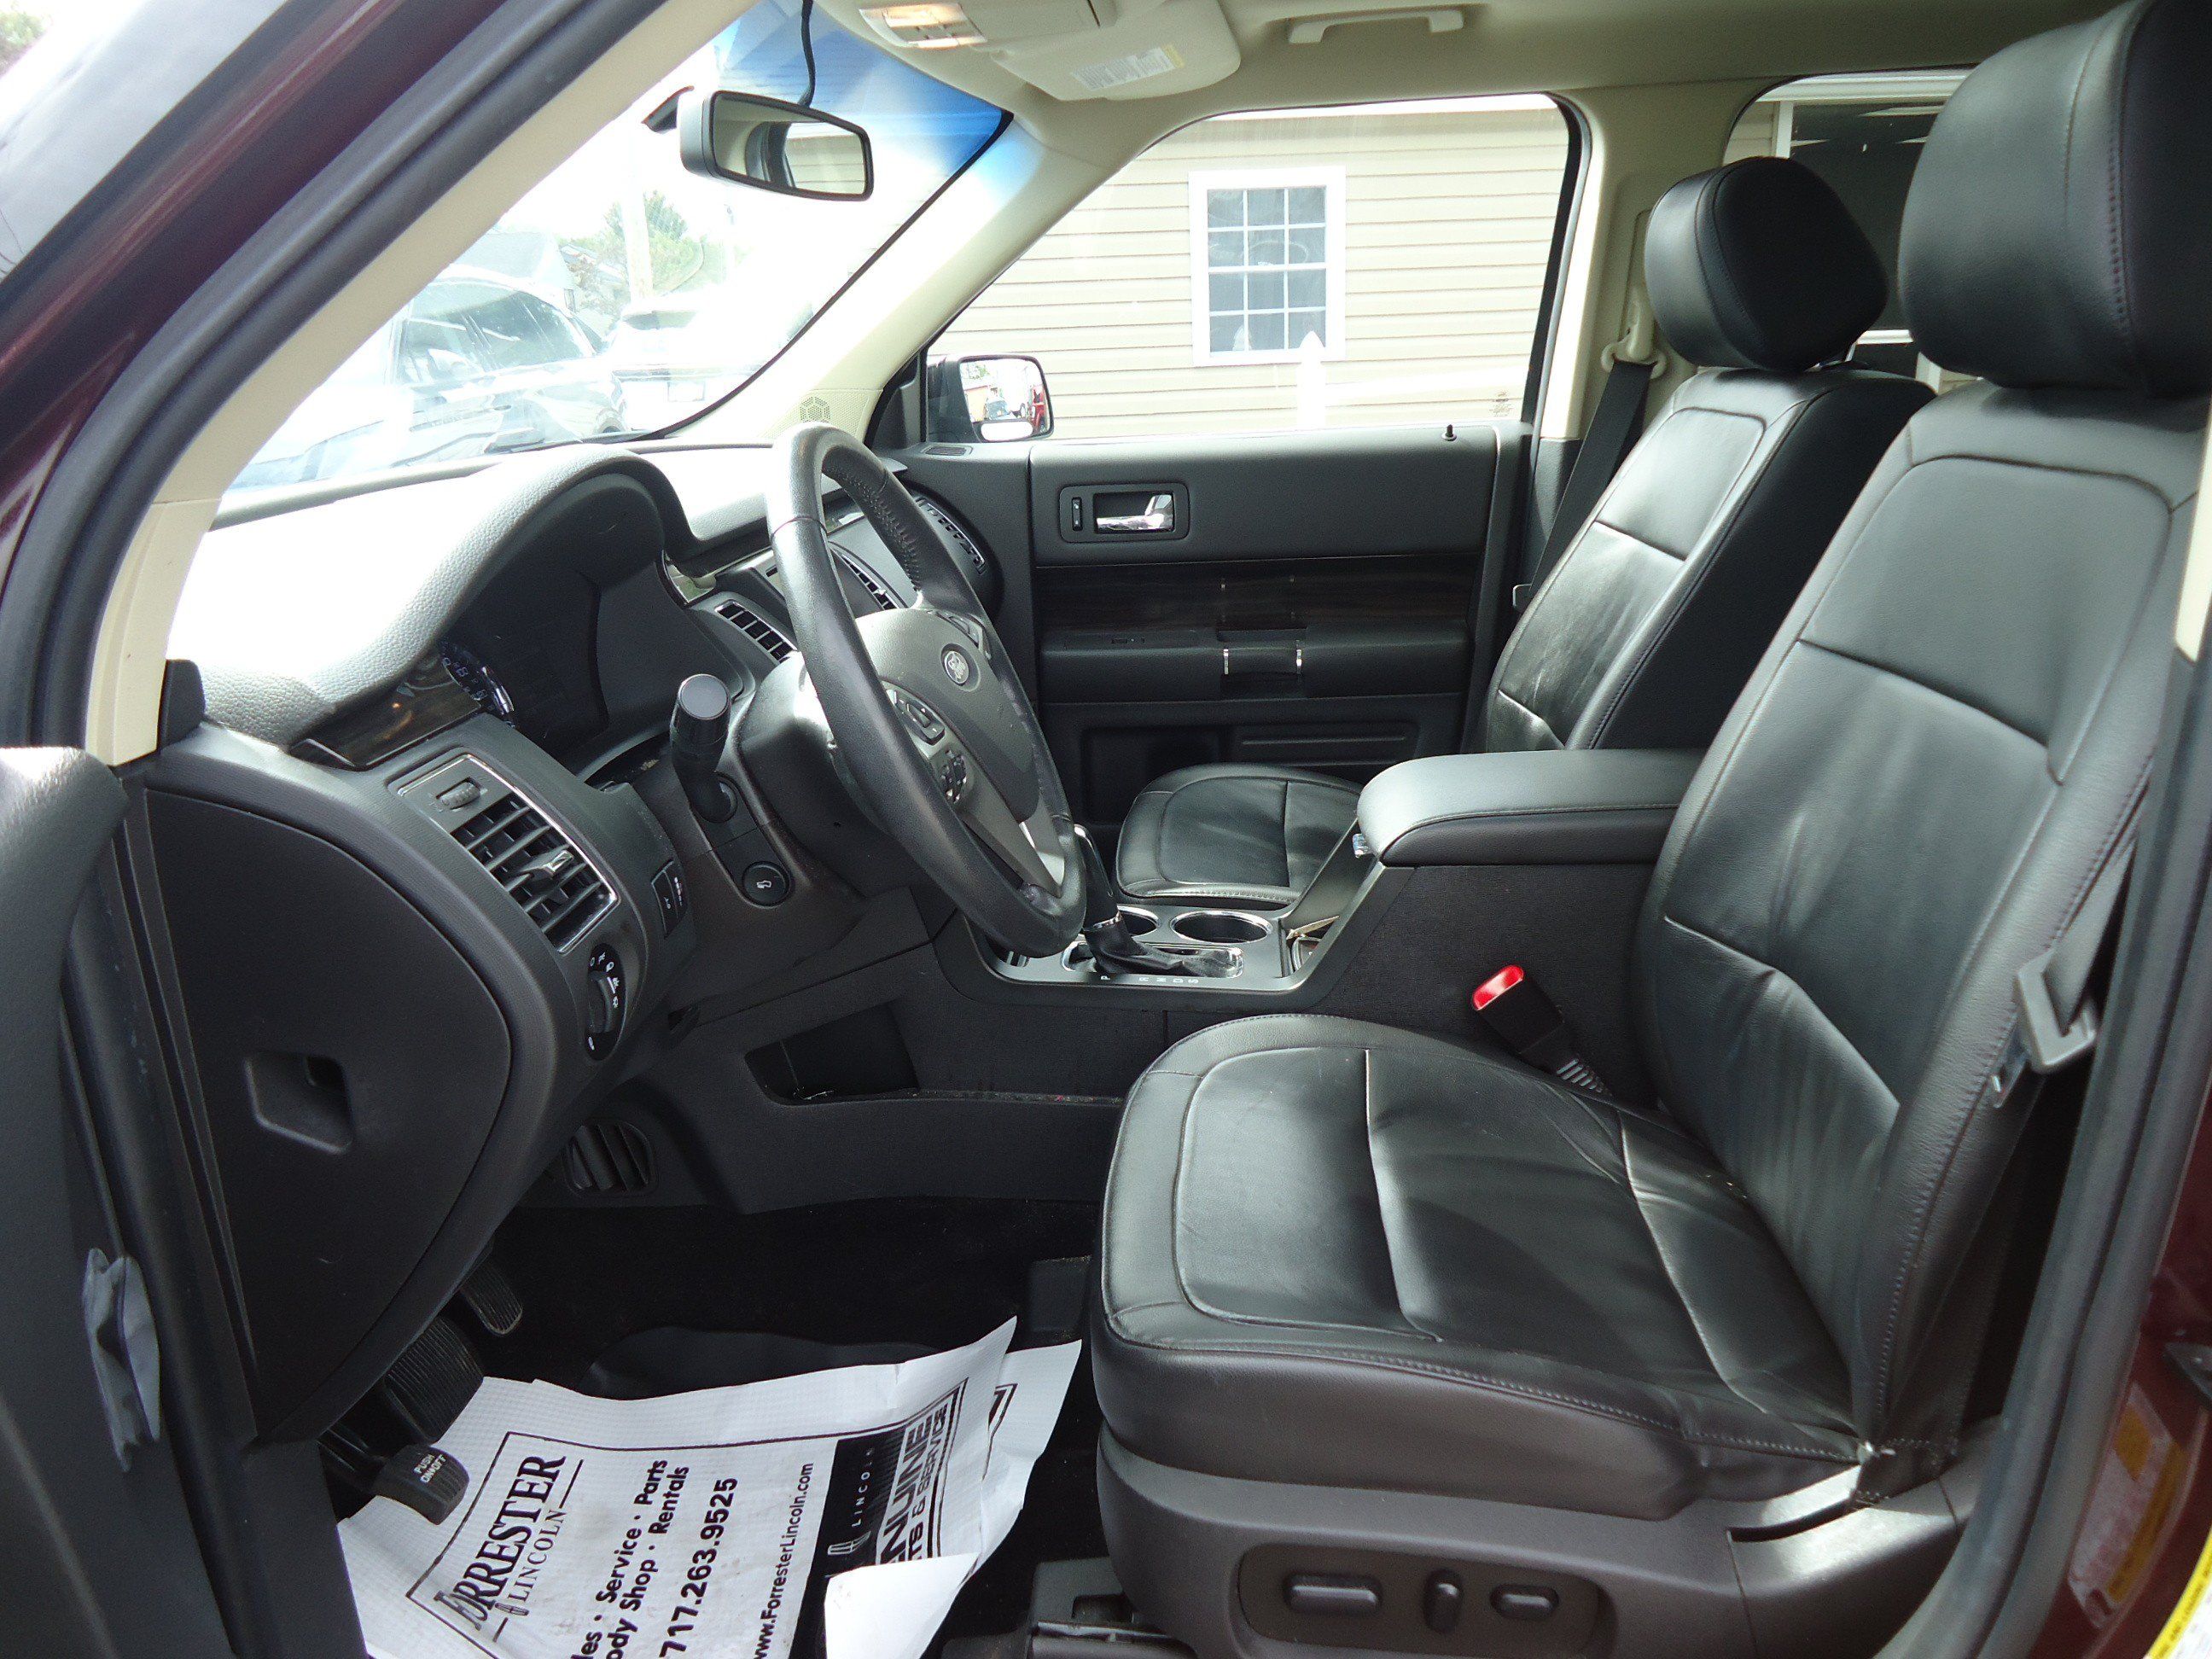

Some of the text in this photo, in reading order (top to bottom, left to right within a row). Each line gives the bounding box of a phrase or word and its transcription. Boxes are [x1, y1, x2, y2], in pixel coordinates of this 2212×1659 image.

[413, 1453, 435, 1474] PUSH
[434, 1456, 567, 1631] FORRESTER
[851, 1447, 876, 1528] LINCOLN
[880, 1415, 933, 1564] NUINE
[908, 1403, 948, 1562] TS & SERVICE
[507, 1509, 567, 1602] LINCOLN
[570, 1459, 668, 1659] les Service Parts
[605, 1466, 690, 1659] ody Shop Rentals
[659, 1477, 738, 1658] 717.263.9525
[753, 1463, 814, 1659] www.ForresterLincoln.com
